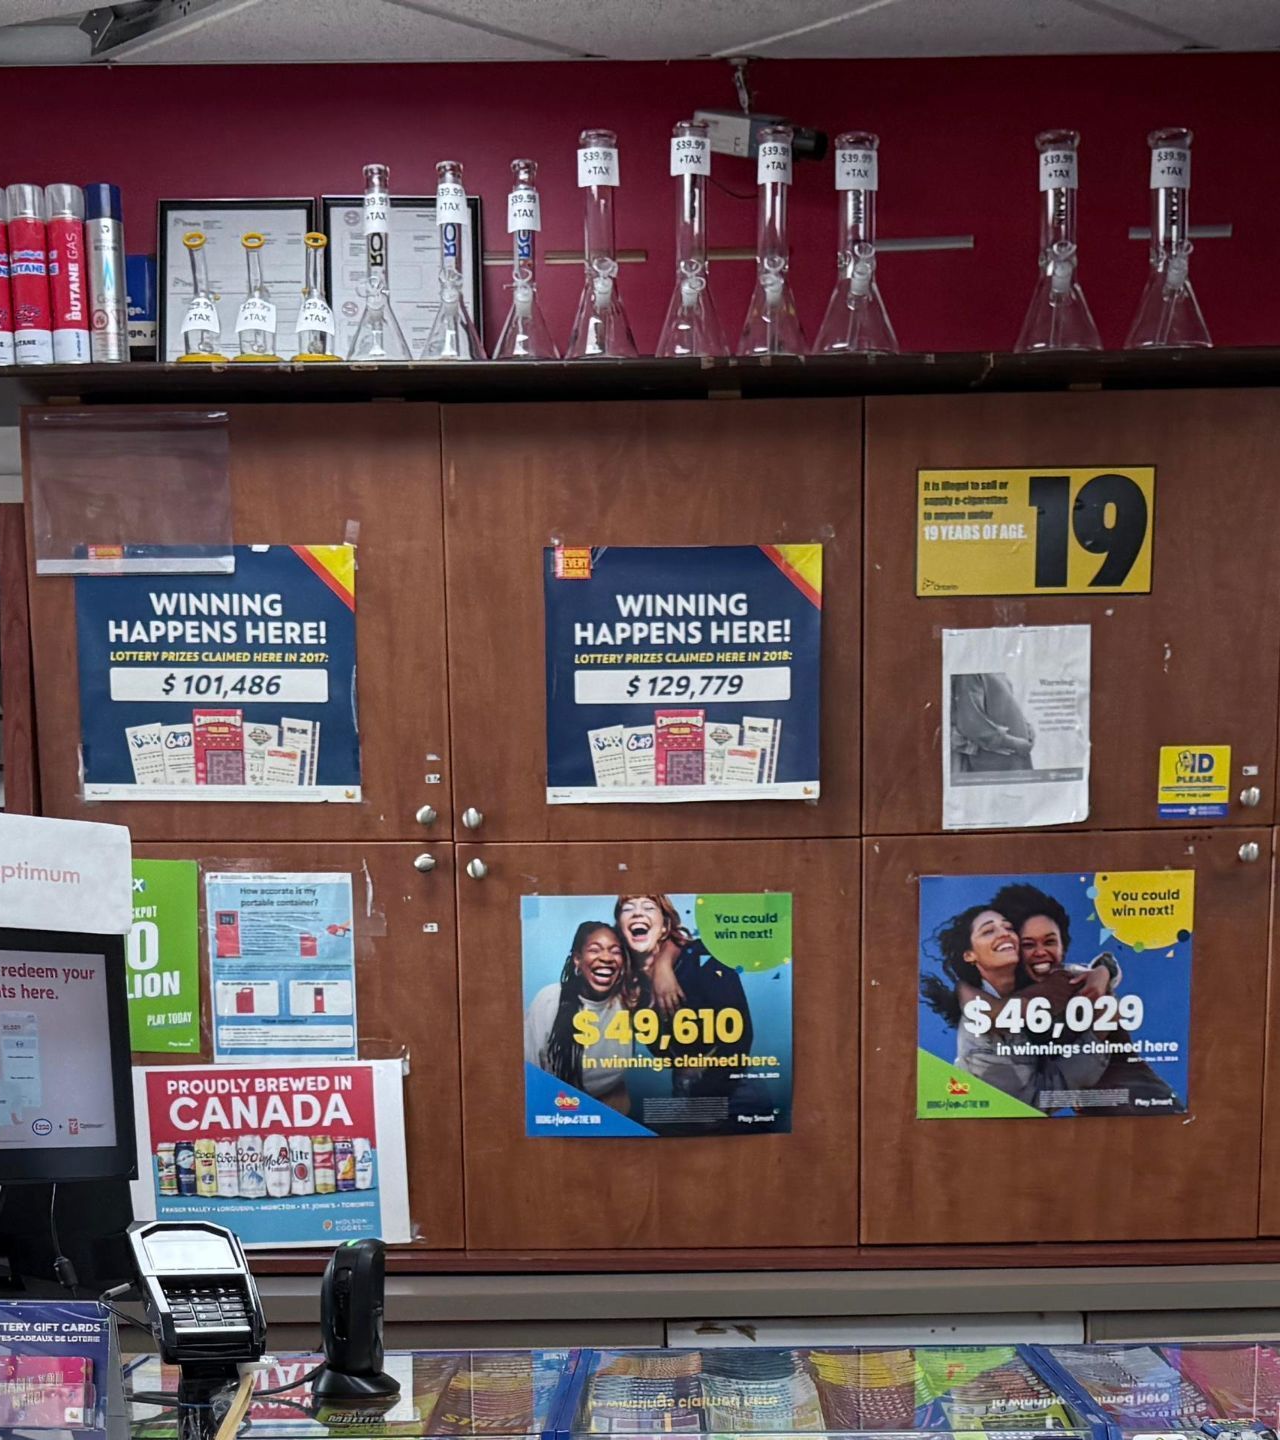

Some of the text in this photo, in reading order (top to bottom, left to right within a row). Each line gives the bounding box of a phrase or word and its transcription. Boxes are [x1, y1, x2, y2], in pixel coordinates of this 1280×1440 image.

[65, 232, 81, 321] BUTANE GAS
[924, 524, 1027, 541] 19 YEARS OF AGE.
[1029, 474, 1148, 588] 19
[149, 593, 282, 617] WINNING
[616, 594, 747, 617] WINNING
[108, 621, 327, 644] HAPPENS HERE!
[574, 620, 791, 645] HAPPENS HERE!
[111, 652, 328, 662] LOTTERY PRIZES CLAIMED HERE IN 2017:
[162, 673, 281, 698] $ 101,486
[626, 675, 743, 699] $ 129,779
[1191, 752, 1213, 773] ID
[240, 887, 258, 896] How
[296, 888, 303, 896] is
[305, 888, 316, 898] my
[241, 898, 318, 909] portable container?
[715, 914, 778, 924] You could
[715, 928, 772, 940] win next!
[1, 963, 58, 980] redeem
[63, 967, 95, 983] your
[21, 984, 58, 1000] here.
[147, 1012, 192, 1026] PLAY TODAY
[963, 994, 1144, 1038] $46,029
[572, 1008, 743, 1050] $49,610
[582, 1054, 780, 1072] in winnings claimed here.
[167, 1076, 352, 1095] PROUDLY BREWED IN
[169, 1093, 353, 1131] CANADA
[34, 1322, 55, 1332] GIFT
[60, 1322, 100, 1332] CARDS
